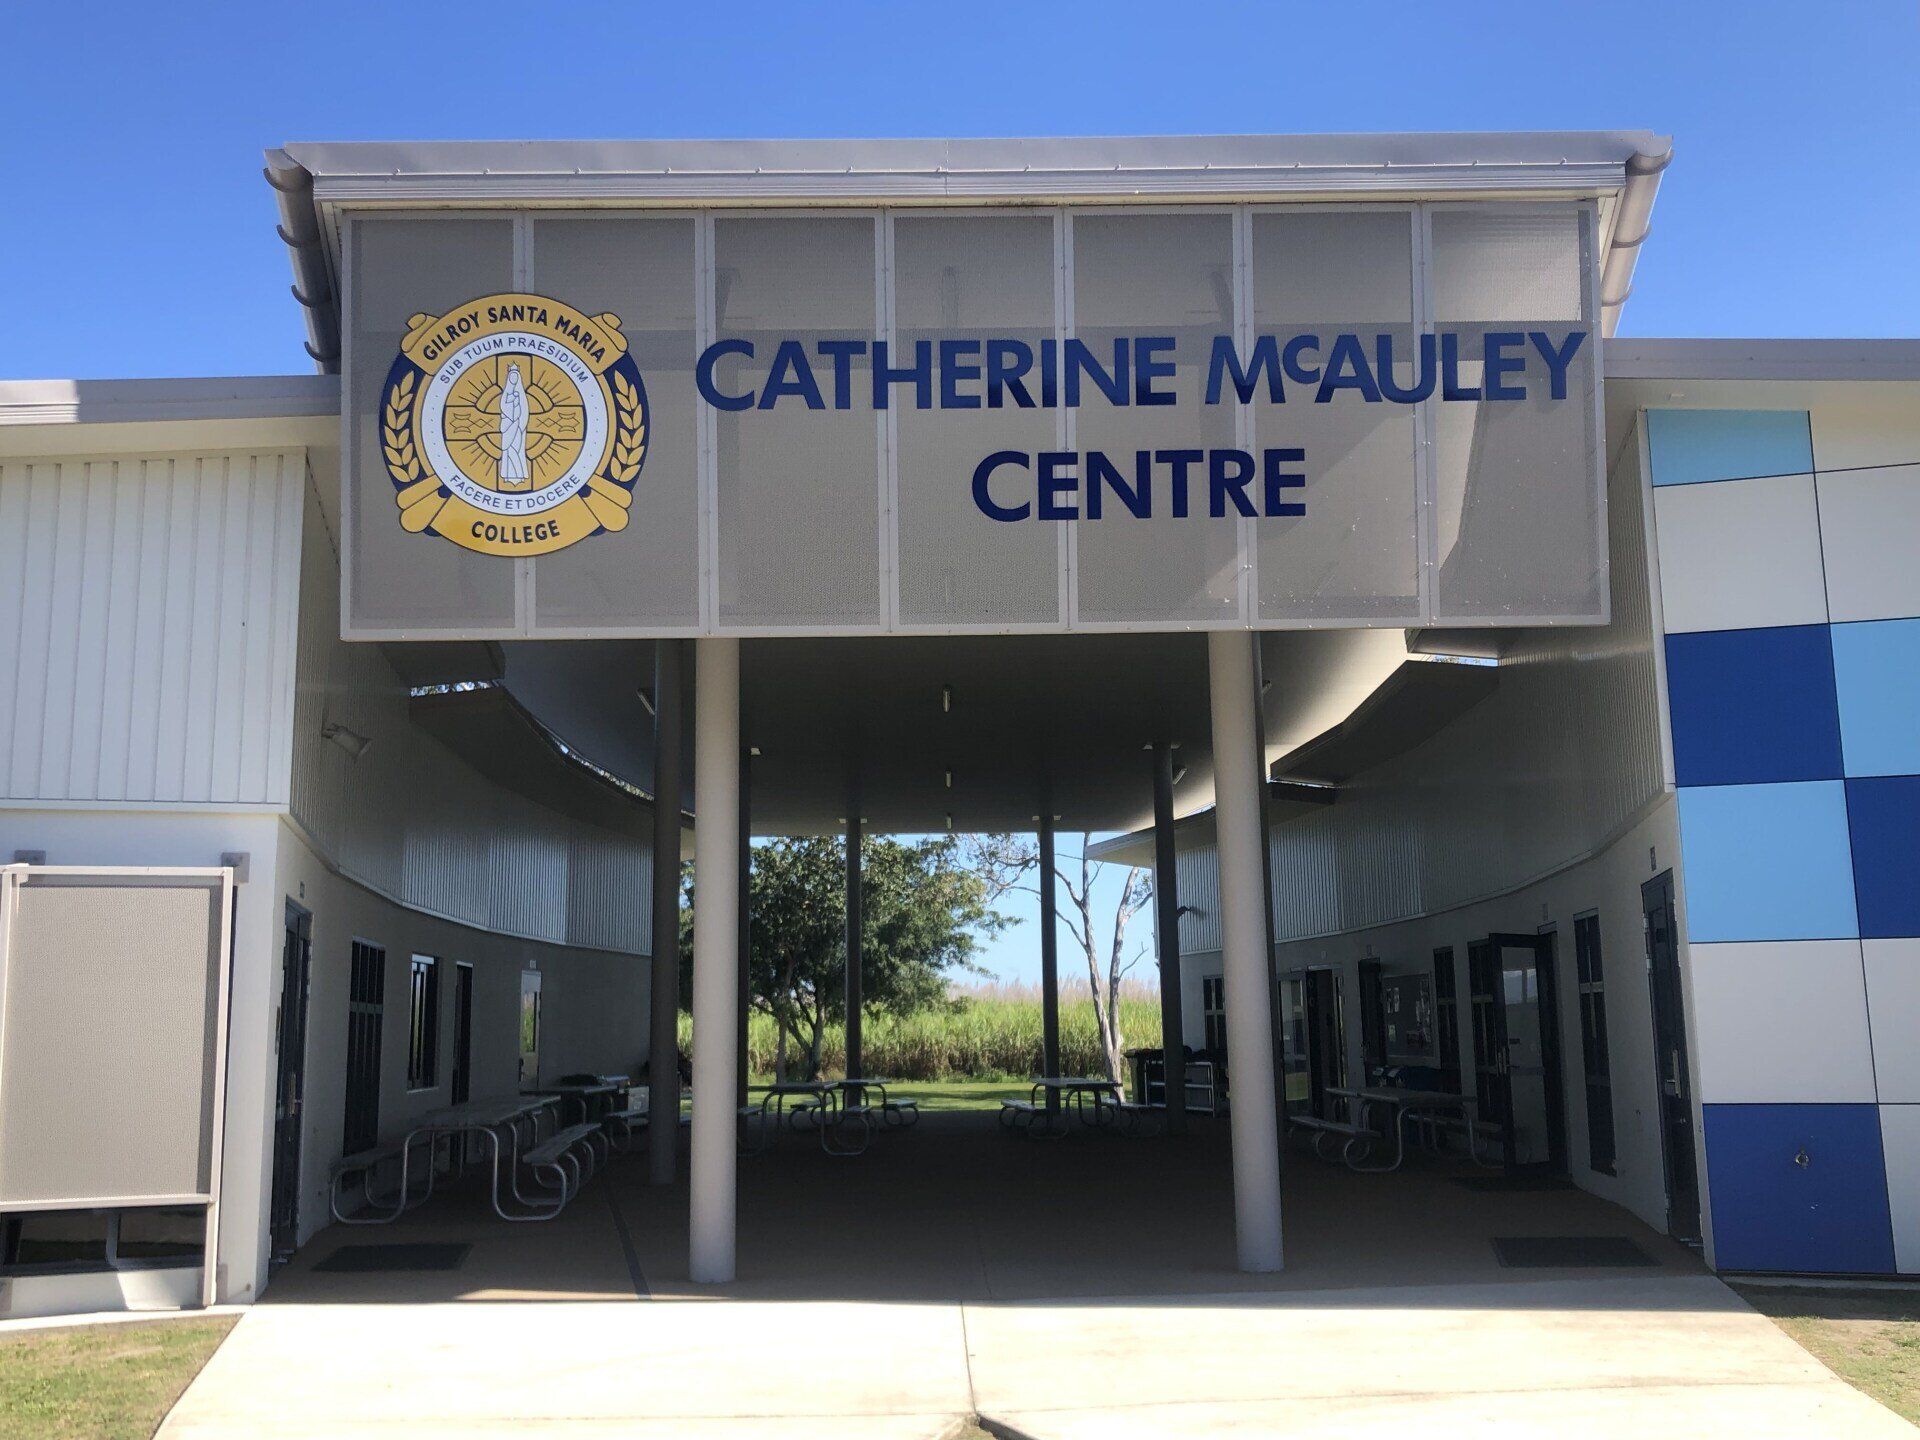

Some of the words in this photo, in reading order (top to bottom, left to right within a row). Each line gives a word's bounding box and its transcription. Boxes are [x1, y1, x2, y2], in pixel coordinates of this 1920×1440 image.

[423, 312, 480, 361] GILROY
[488, 306, 548, 326] SANTA
[555, 316, 606, 363] MARIA
[440, 358, 464, 384] SUB
[464, 338, 504, 360] TUUM
[508, 337, 589, 384] PRAESIDIUM
[695, 338, 1177, 412] CATHERINE
[450, 475, 502, 509] FACERE
[505, 499, 523, 510] ET
[527, 474, 581, 509] DOCERE
[971, 448, 1306, 522] CENTRE
[471, 520, 560, 544] COLLEGE
